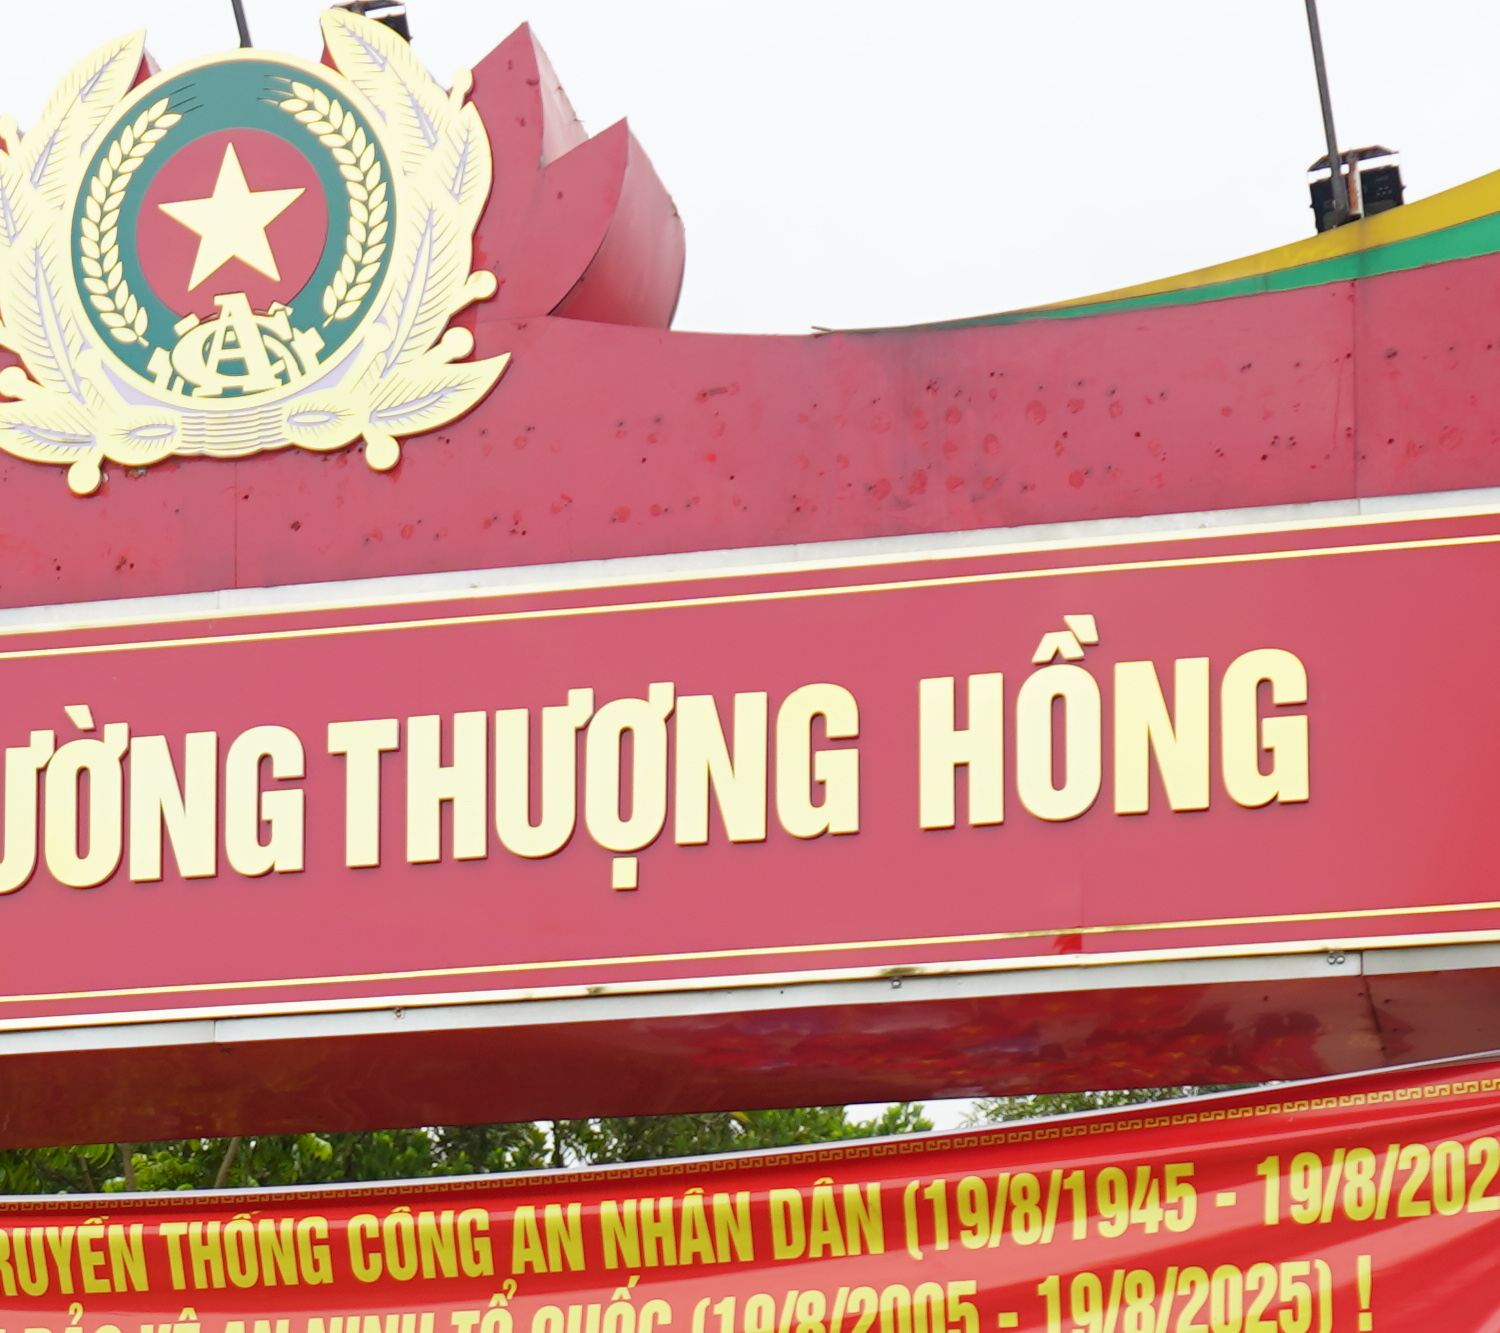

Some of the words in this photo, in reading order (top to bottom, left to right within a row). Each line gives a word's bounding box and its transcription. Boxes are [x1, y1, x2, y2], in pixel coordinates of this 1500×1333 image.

[328, 681, 861, 891] THƯỢNG
[919, 613, 1311, 831] HỒNG
[159, 1211, 335, 1293] THỐNG
[347, 1206, 495, 1284] CÔNG
[511, 1203, 587, 1276] AN
[600, 1187, 756, 1270] NHÂN
[769, 1178, 886, 1262] DÂN
[903, 1161, 1199, 1262] (19/8/1945
[1215, 1192, 1238, 1209] -
[997, 1311, 1020, 1329] -
[1356, 1255, 1375, 1333] !
